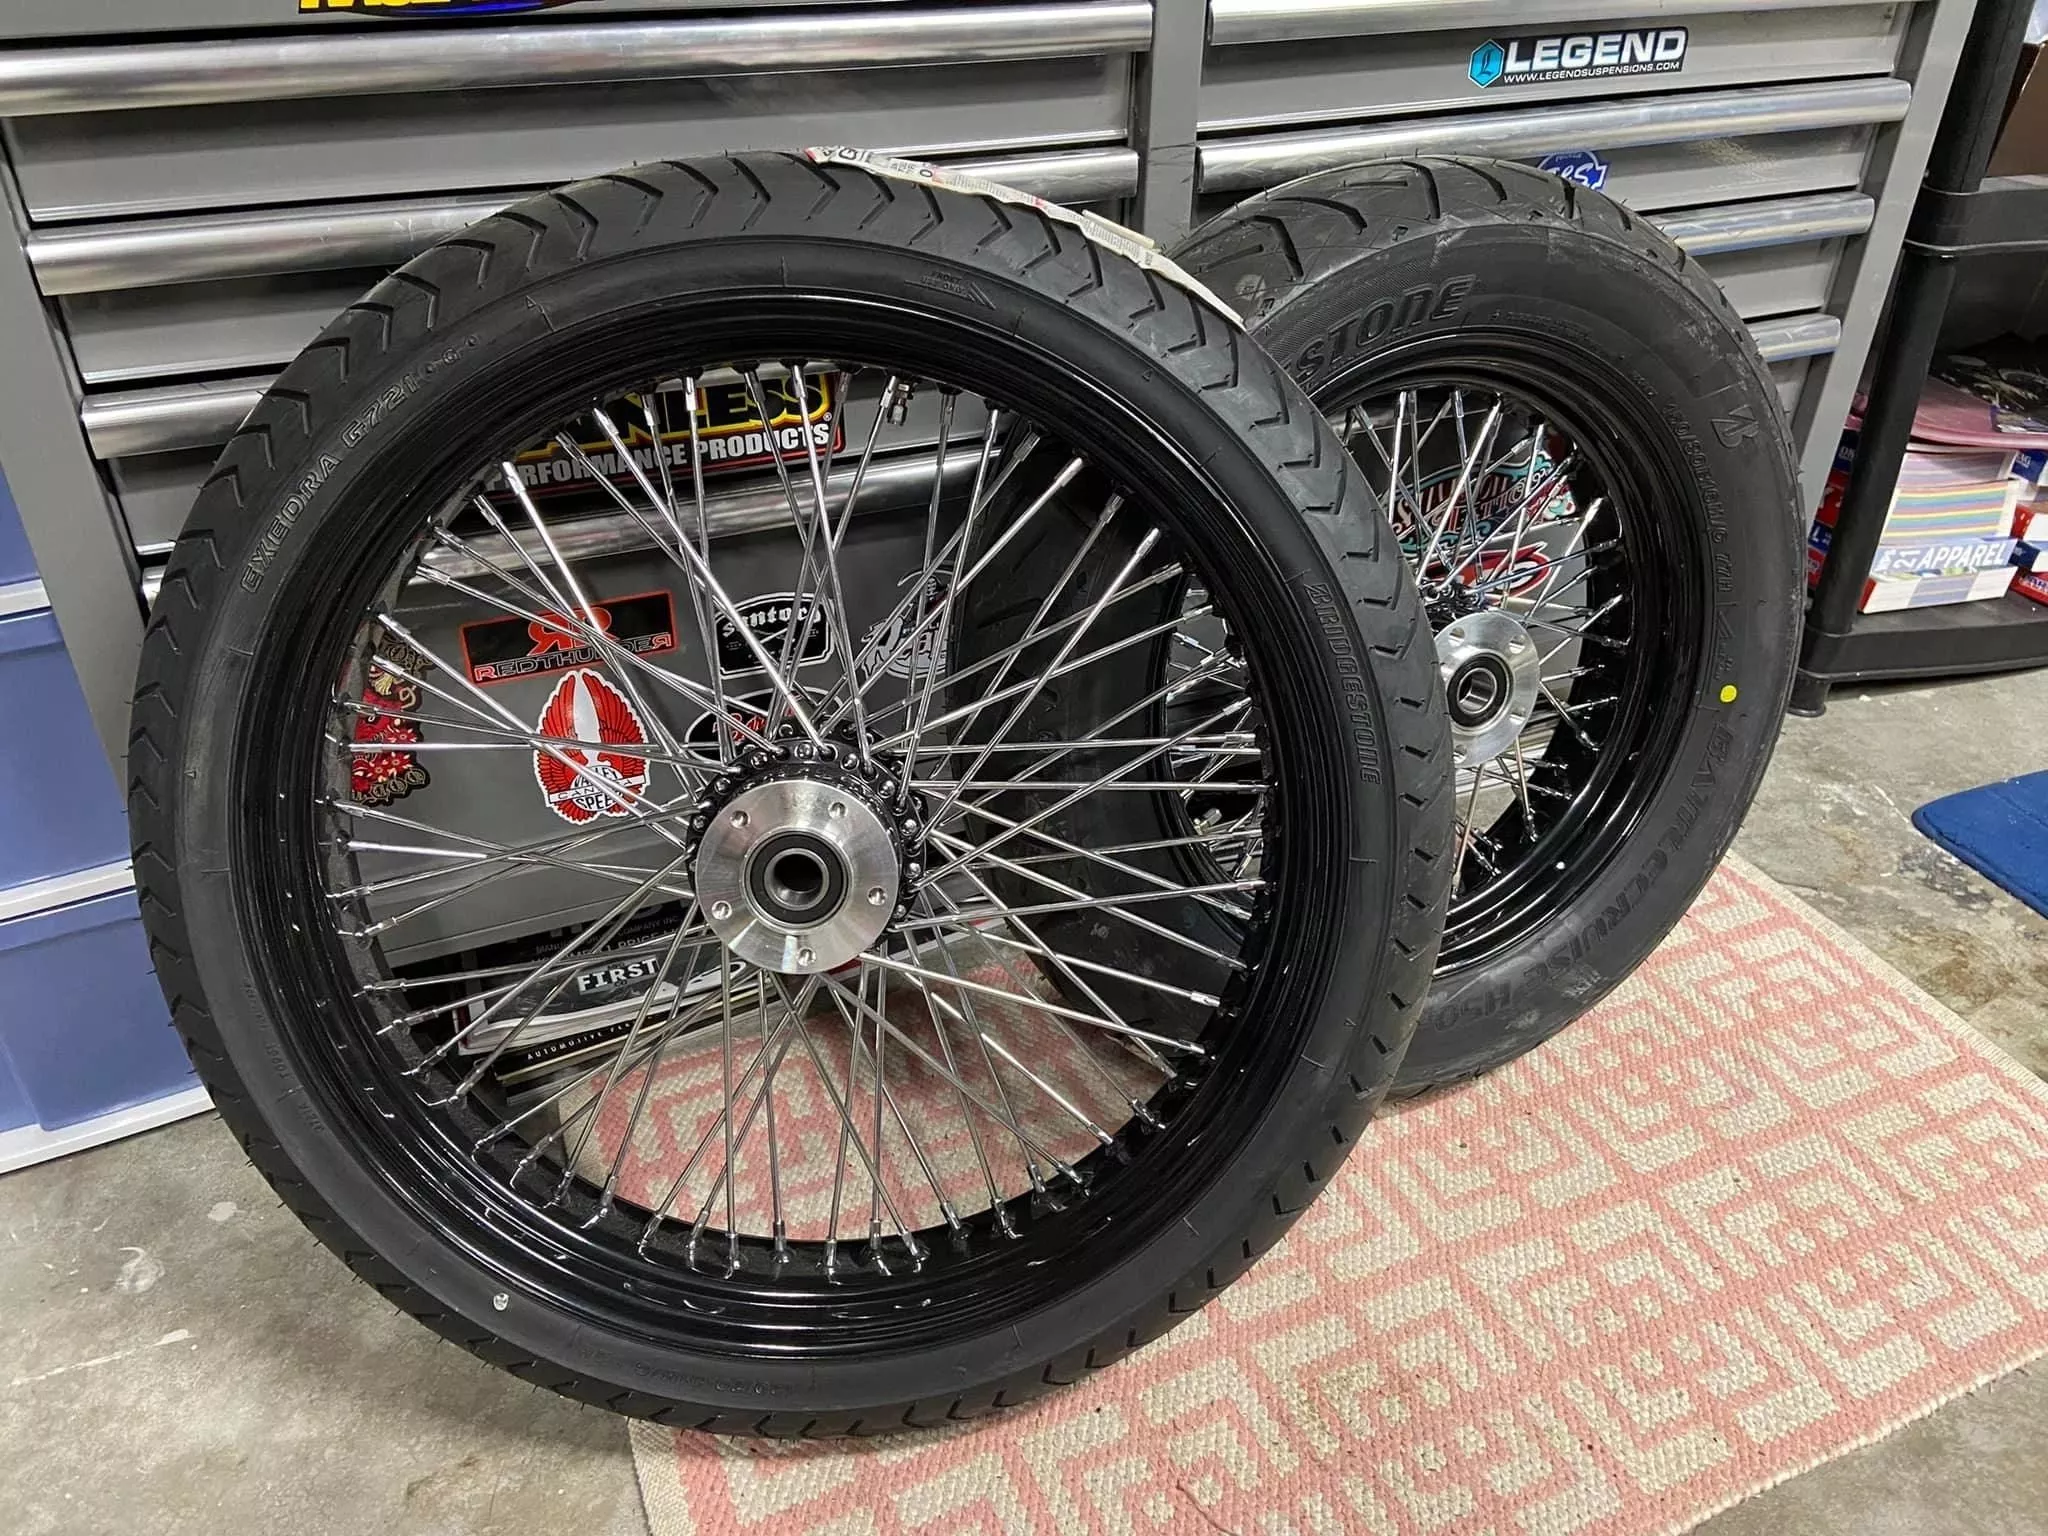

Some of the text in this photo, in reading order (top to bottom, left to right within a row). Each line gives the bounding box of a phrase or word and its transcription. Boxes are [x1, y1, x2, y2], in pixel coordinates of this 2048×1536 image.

[1504, 30, 1687, 73] LEGEND
[1504, 61, 1680, 84] WWW.LEGENDSUSPENSIONS.COM
[1286, 273, 1478, 386] STONE
[699, 422, 831, 461] PRODUCTS
[240, 372, 420, 594] EXEDRA G721
[1915, 543, 2007, 571] APPAREL
[1303, 583, 1383, 785] BRIDGESTONE
[580, 957, 658, 992] FIRST
